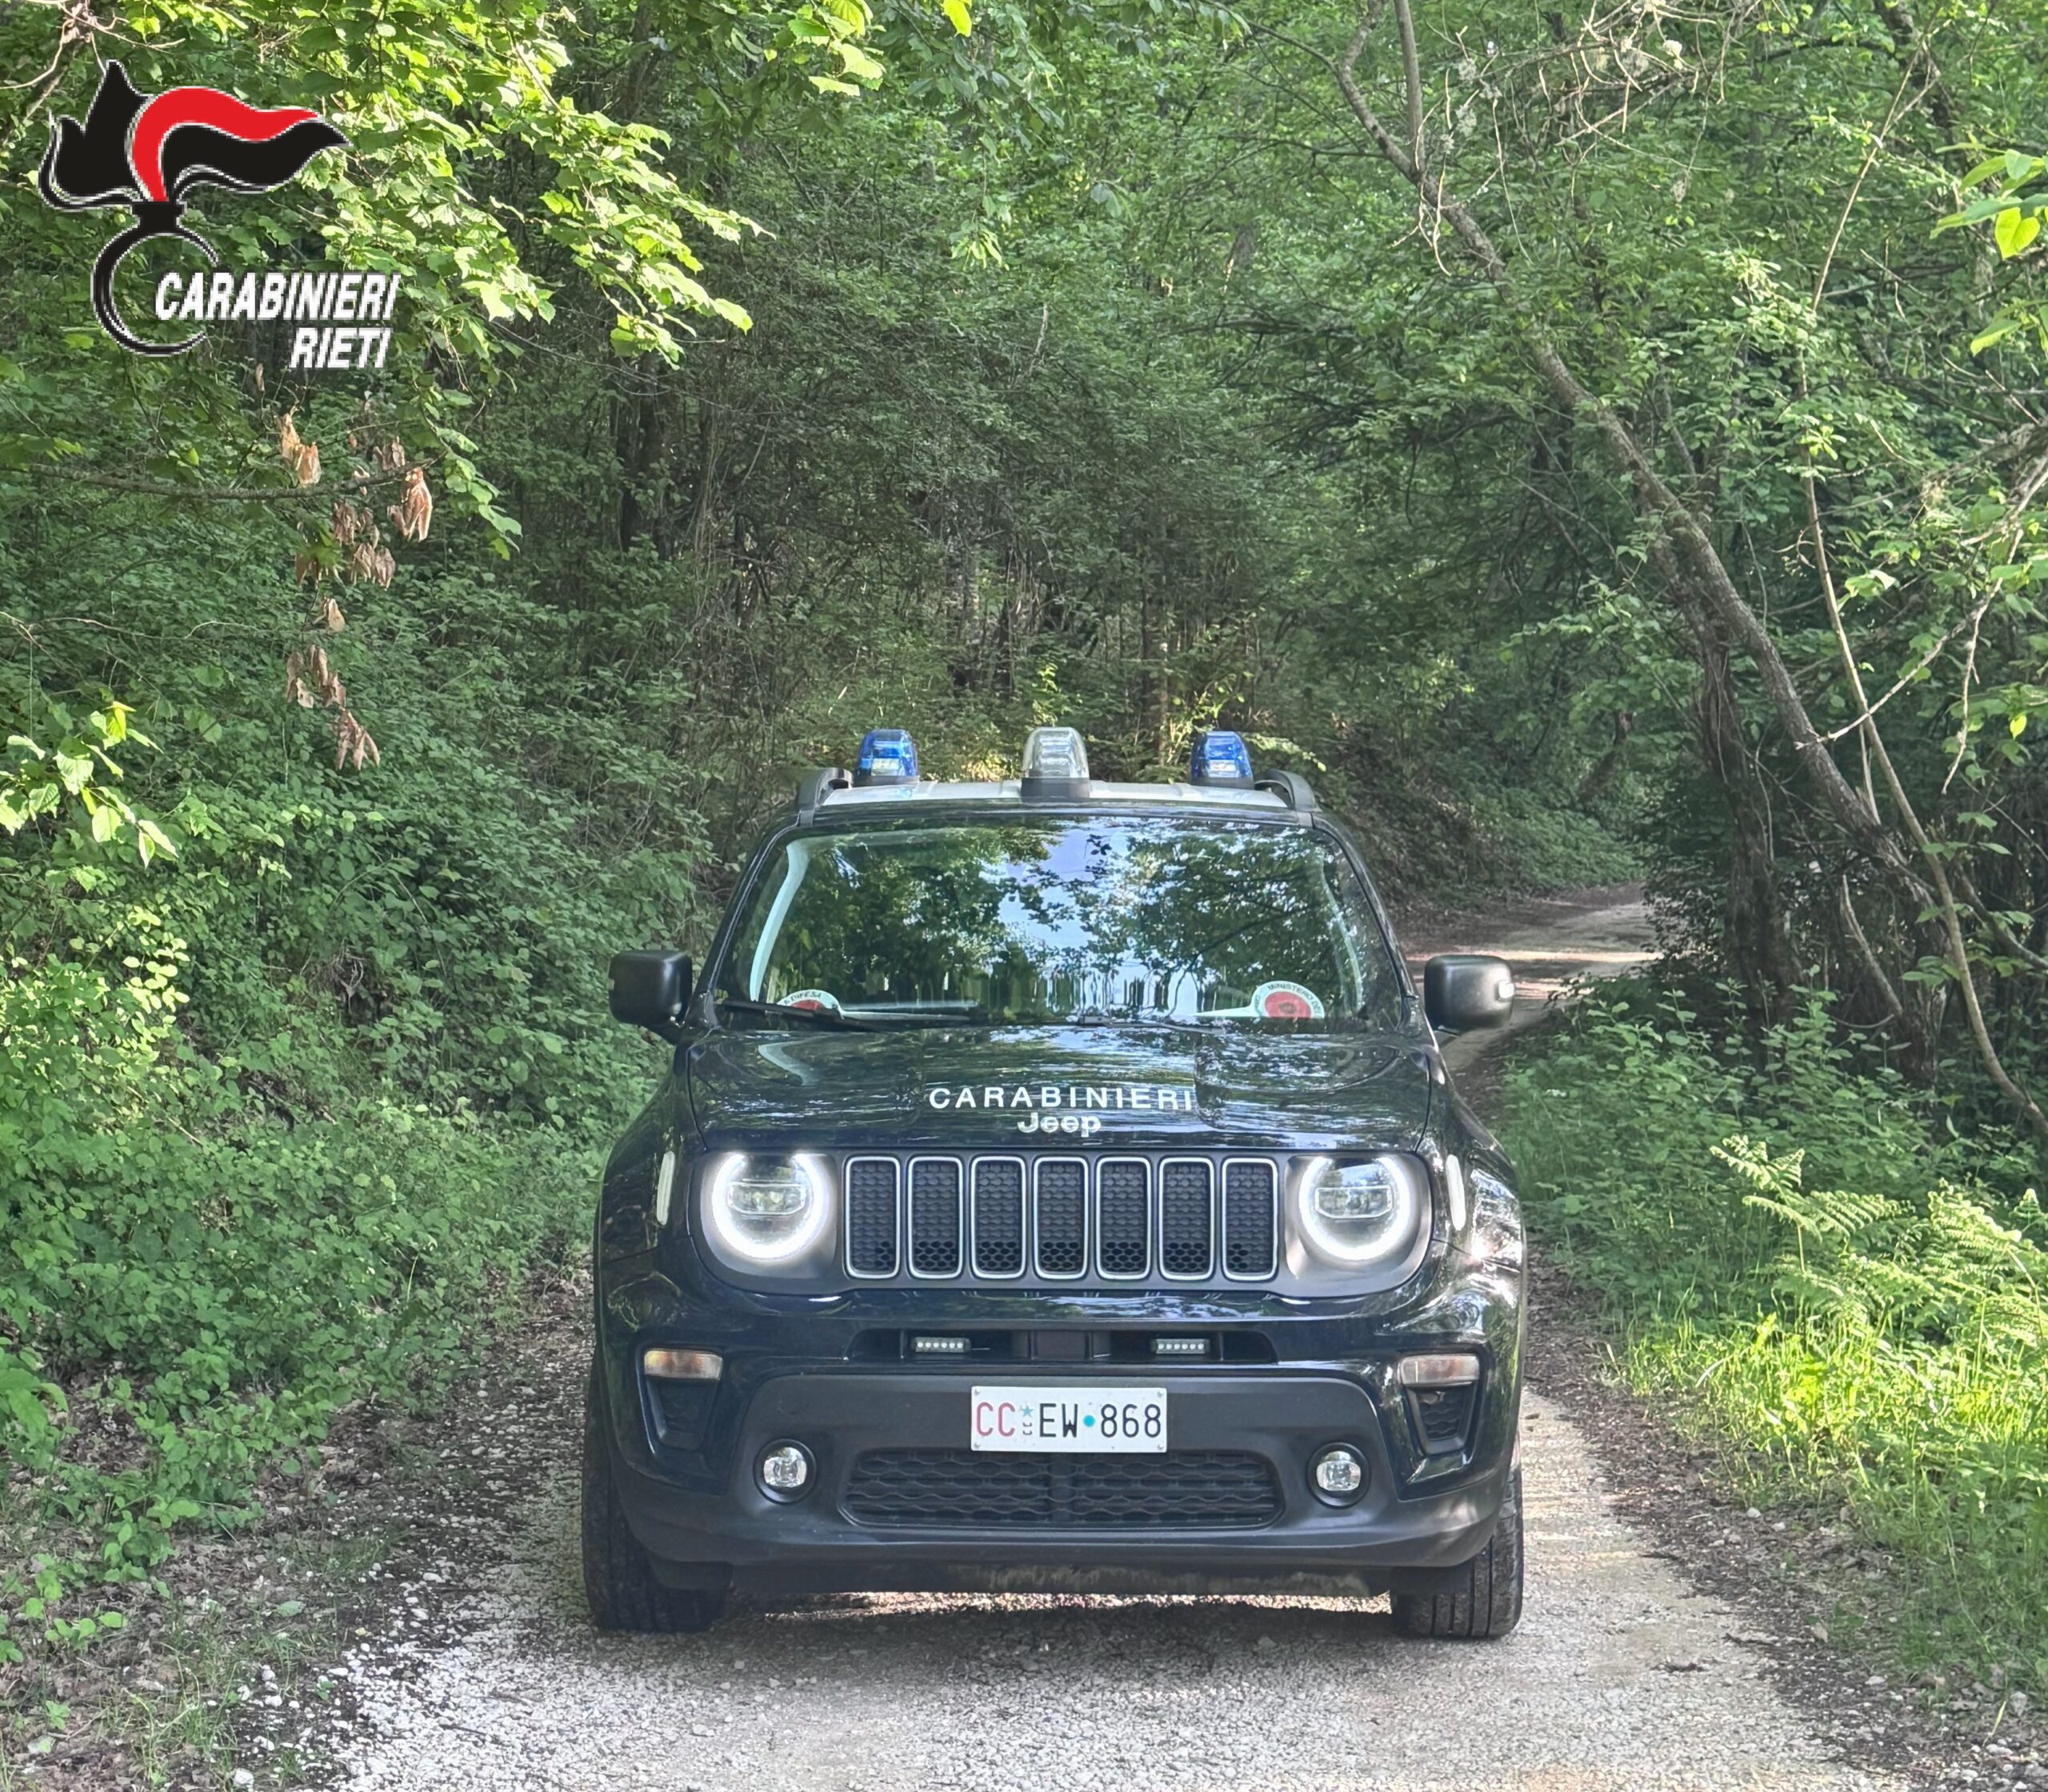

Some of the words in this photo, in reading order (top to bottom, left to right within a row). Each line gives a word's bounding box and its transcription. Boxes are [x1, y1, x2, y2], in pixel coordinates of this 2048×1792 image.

[929, 1086, 1192, 1110] CARABINIERI
[1017, 1111, 1102, 1137] Jeep
[976, 1402, 1015, 1437] CC
[1039, 1402, 1078, 1438] EW
[1100, 1403, 1162, 1438] 868
